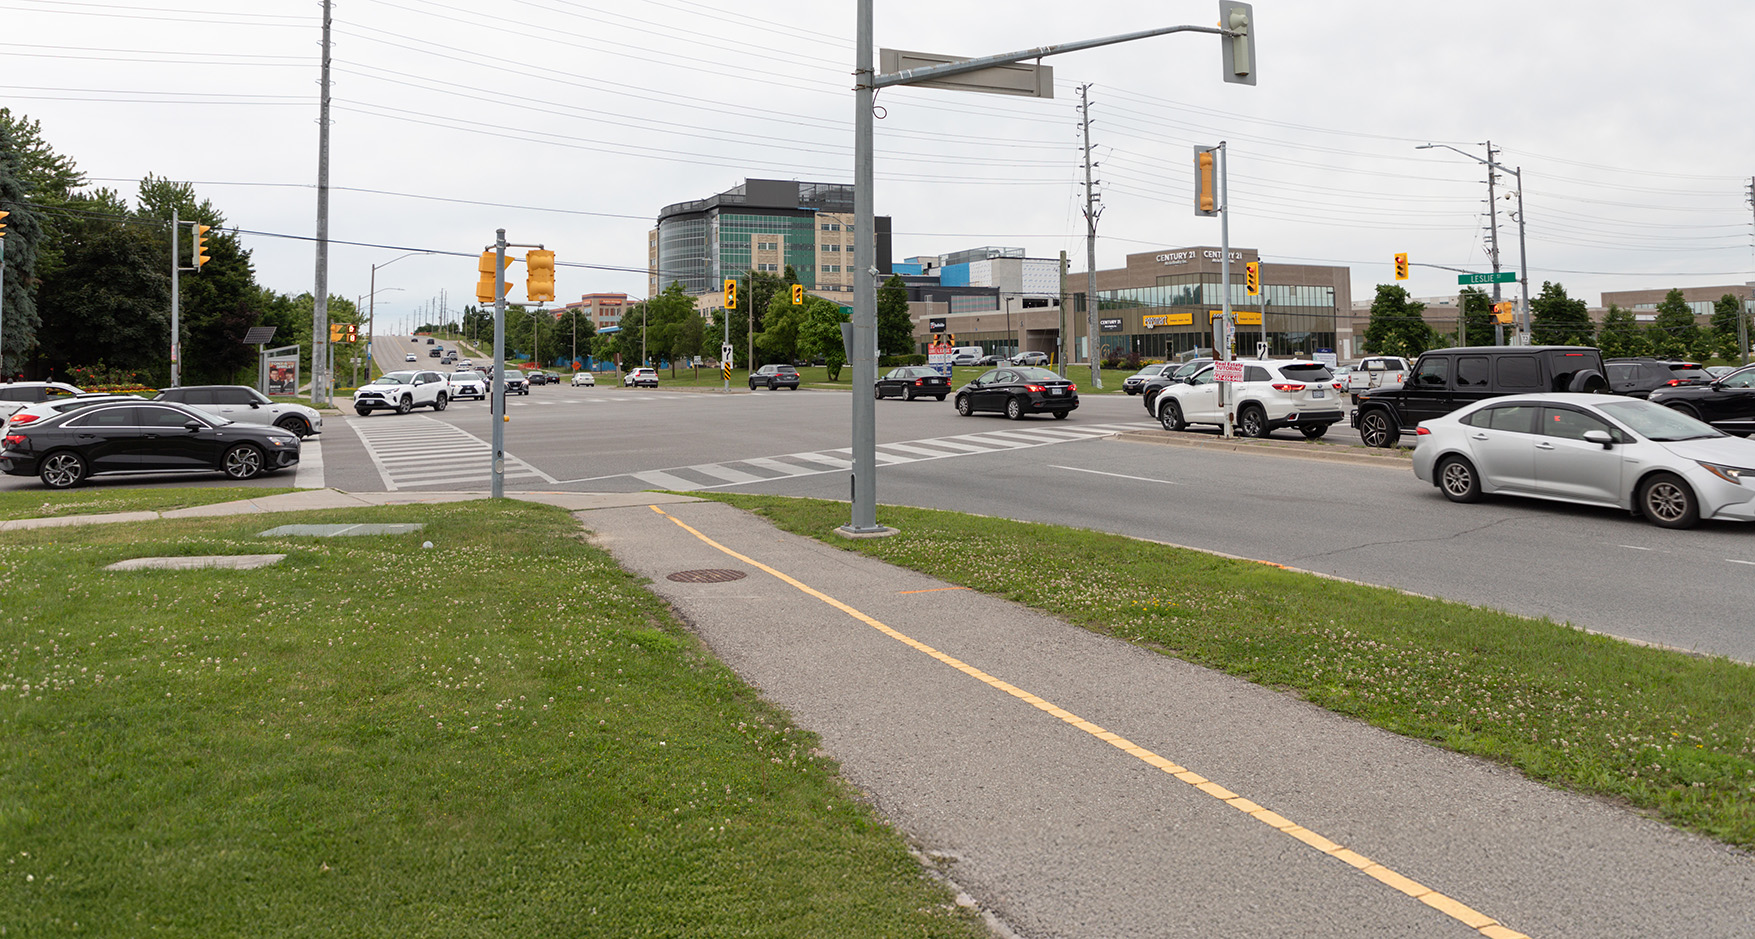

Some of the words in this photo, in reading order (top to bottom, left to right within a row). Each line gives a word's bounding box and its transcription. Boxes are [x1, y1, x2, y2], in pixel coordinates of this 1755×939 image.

[1156, 252, 1188, 262] CENTURY
[1188, 250, 1196, 258] 21
[1203, 250, 1235, 259] CENTRY
[1470, 274, 1494, 282] LESLIE
